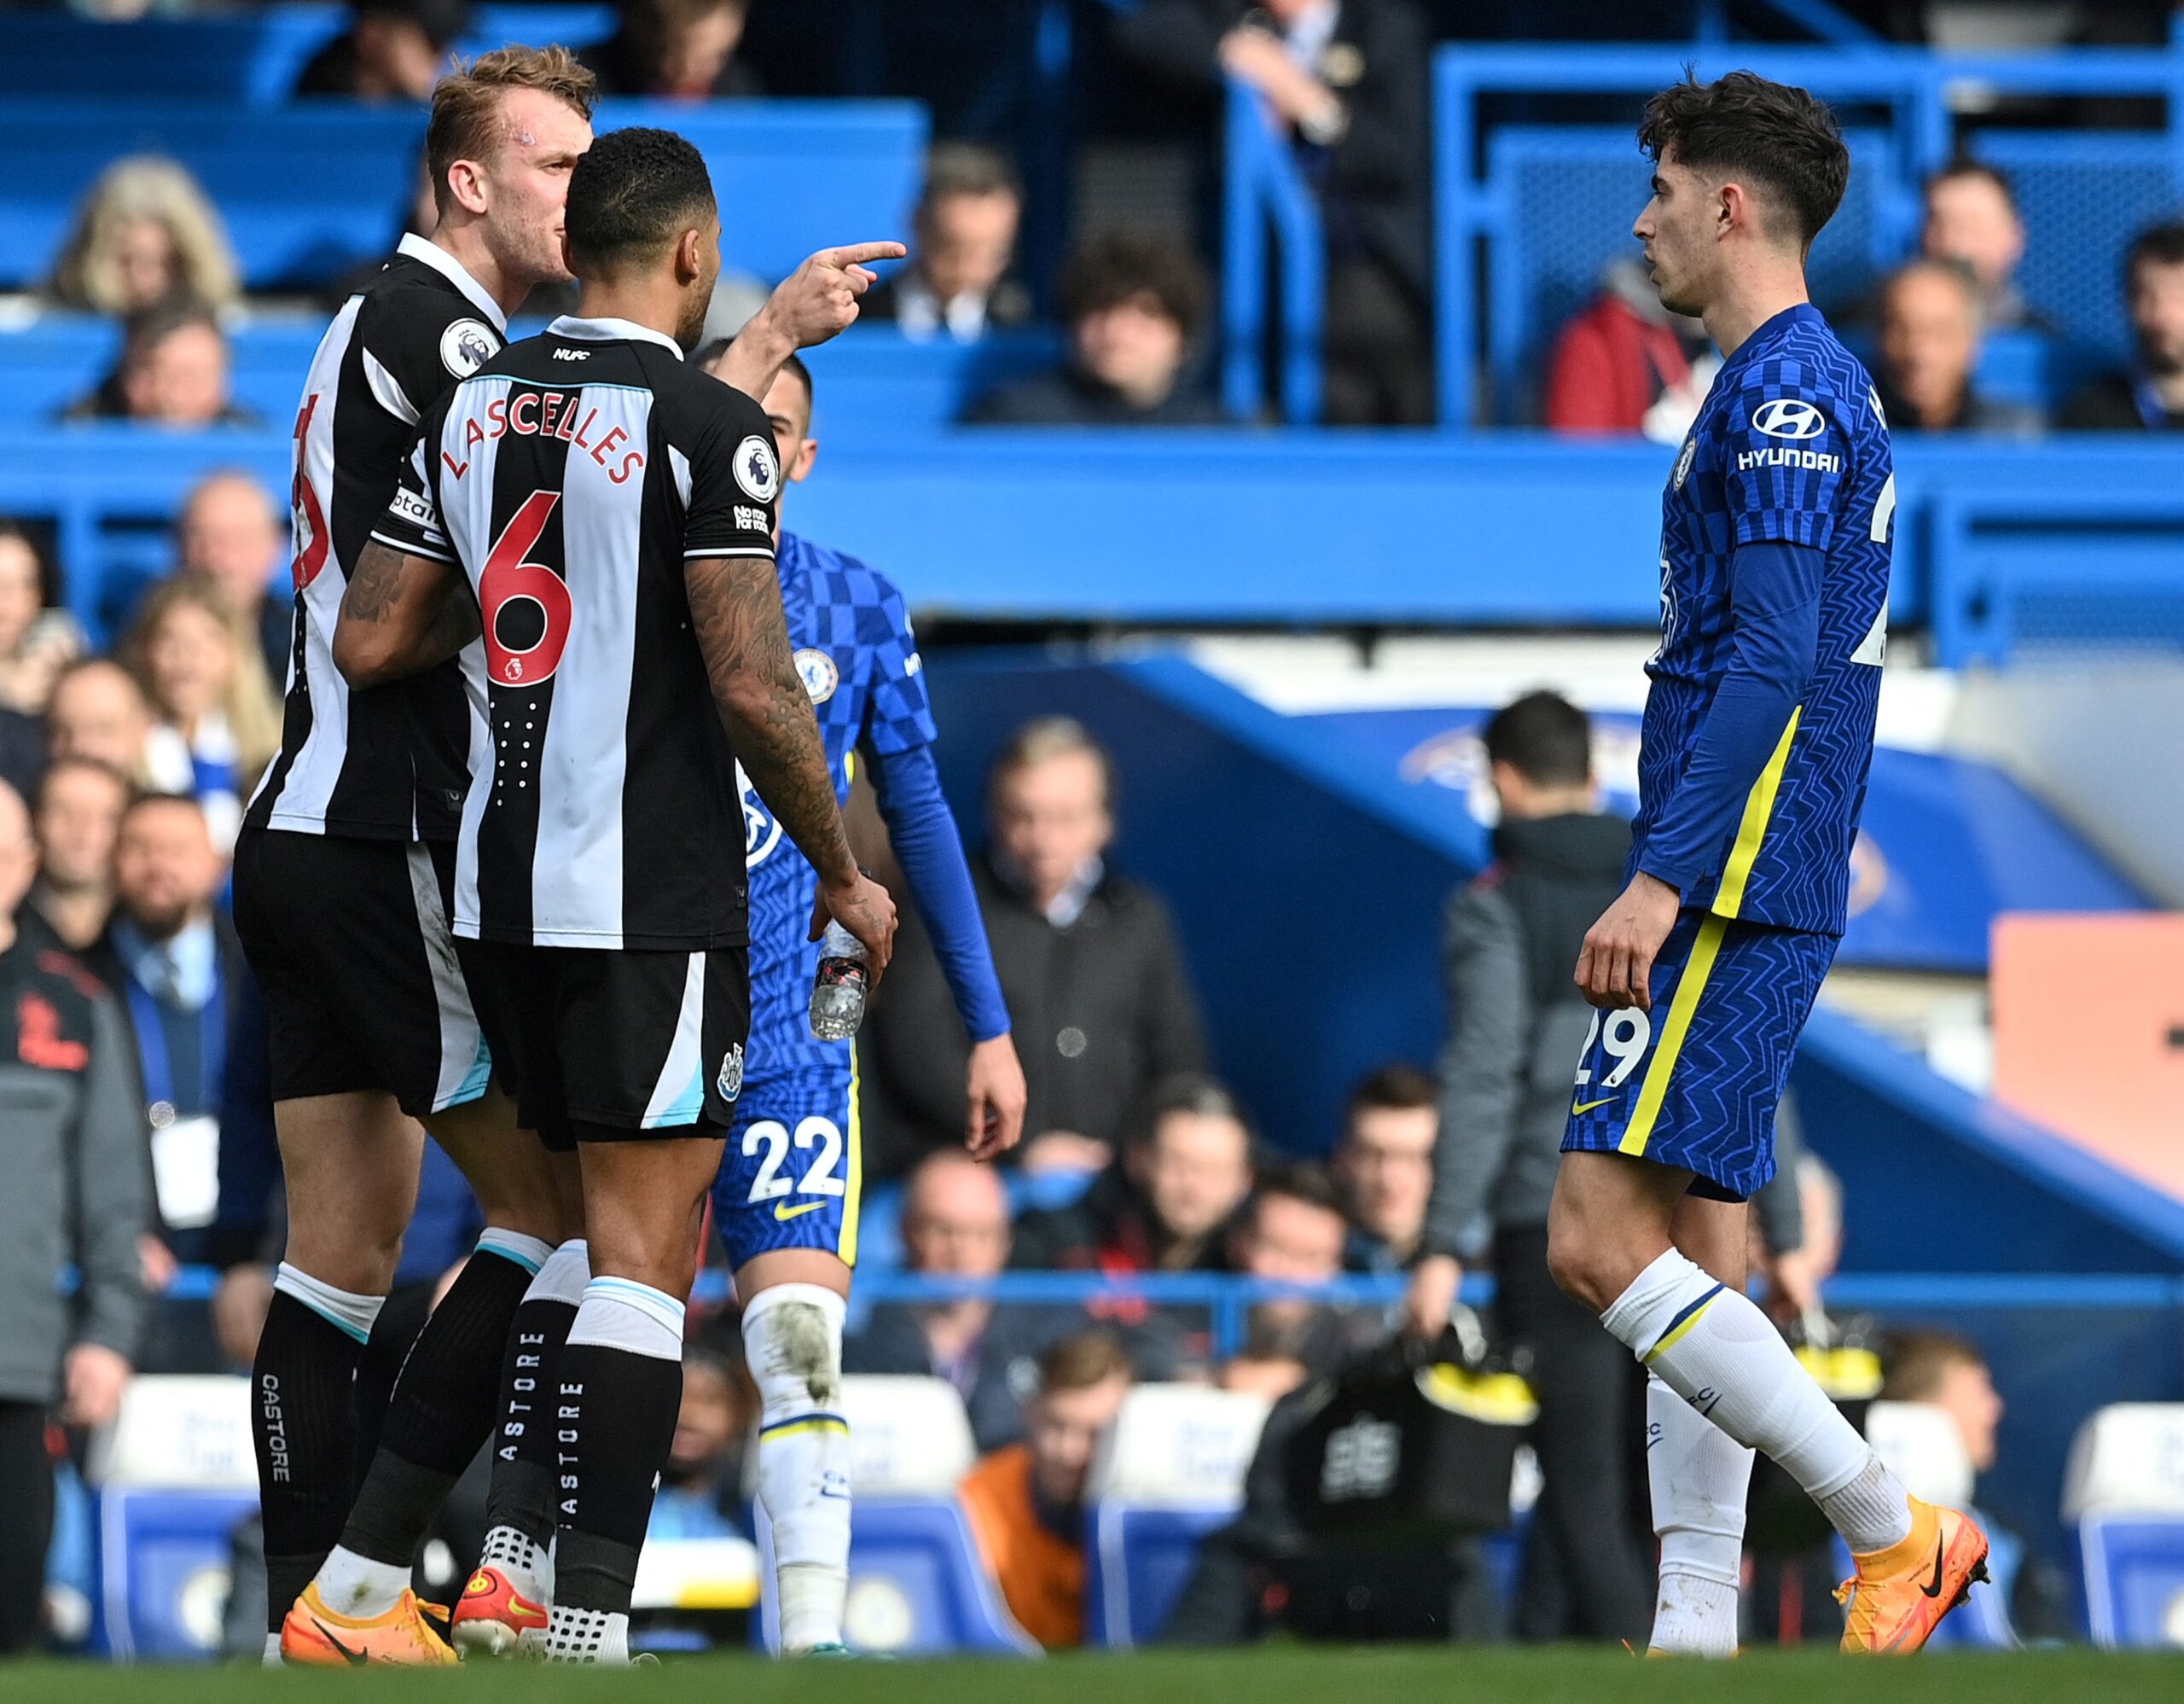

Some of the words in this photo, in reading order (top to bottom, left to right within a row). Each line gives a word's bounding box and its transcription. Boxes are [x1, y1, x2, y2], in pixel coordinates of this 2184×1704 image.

[553, 348, 591, 361] NUFC
[441, 392, 645, 486] LASCELLES
[1738, 447, 1839, 474] HYUNDAI
[479, 490, 572, 688] 6
[1574, 1005, 1651, 1088] 29
[741, 1115, 847, 1205] 22
[262, 1373, 290, 1483] CASTORE
[558, 1382, 584, 1529] ASTORE
